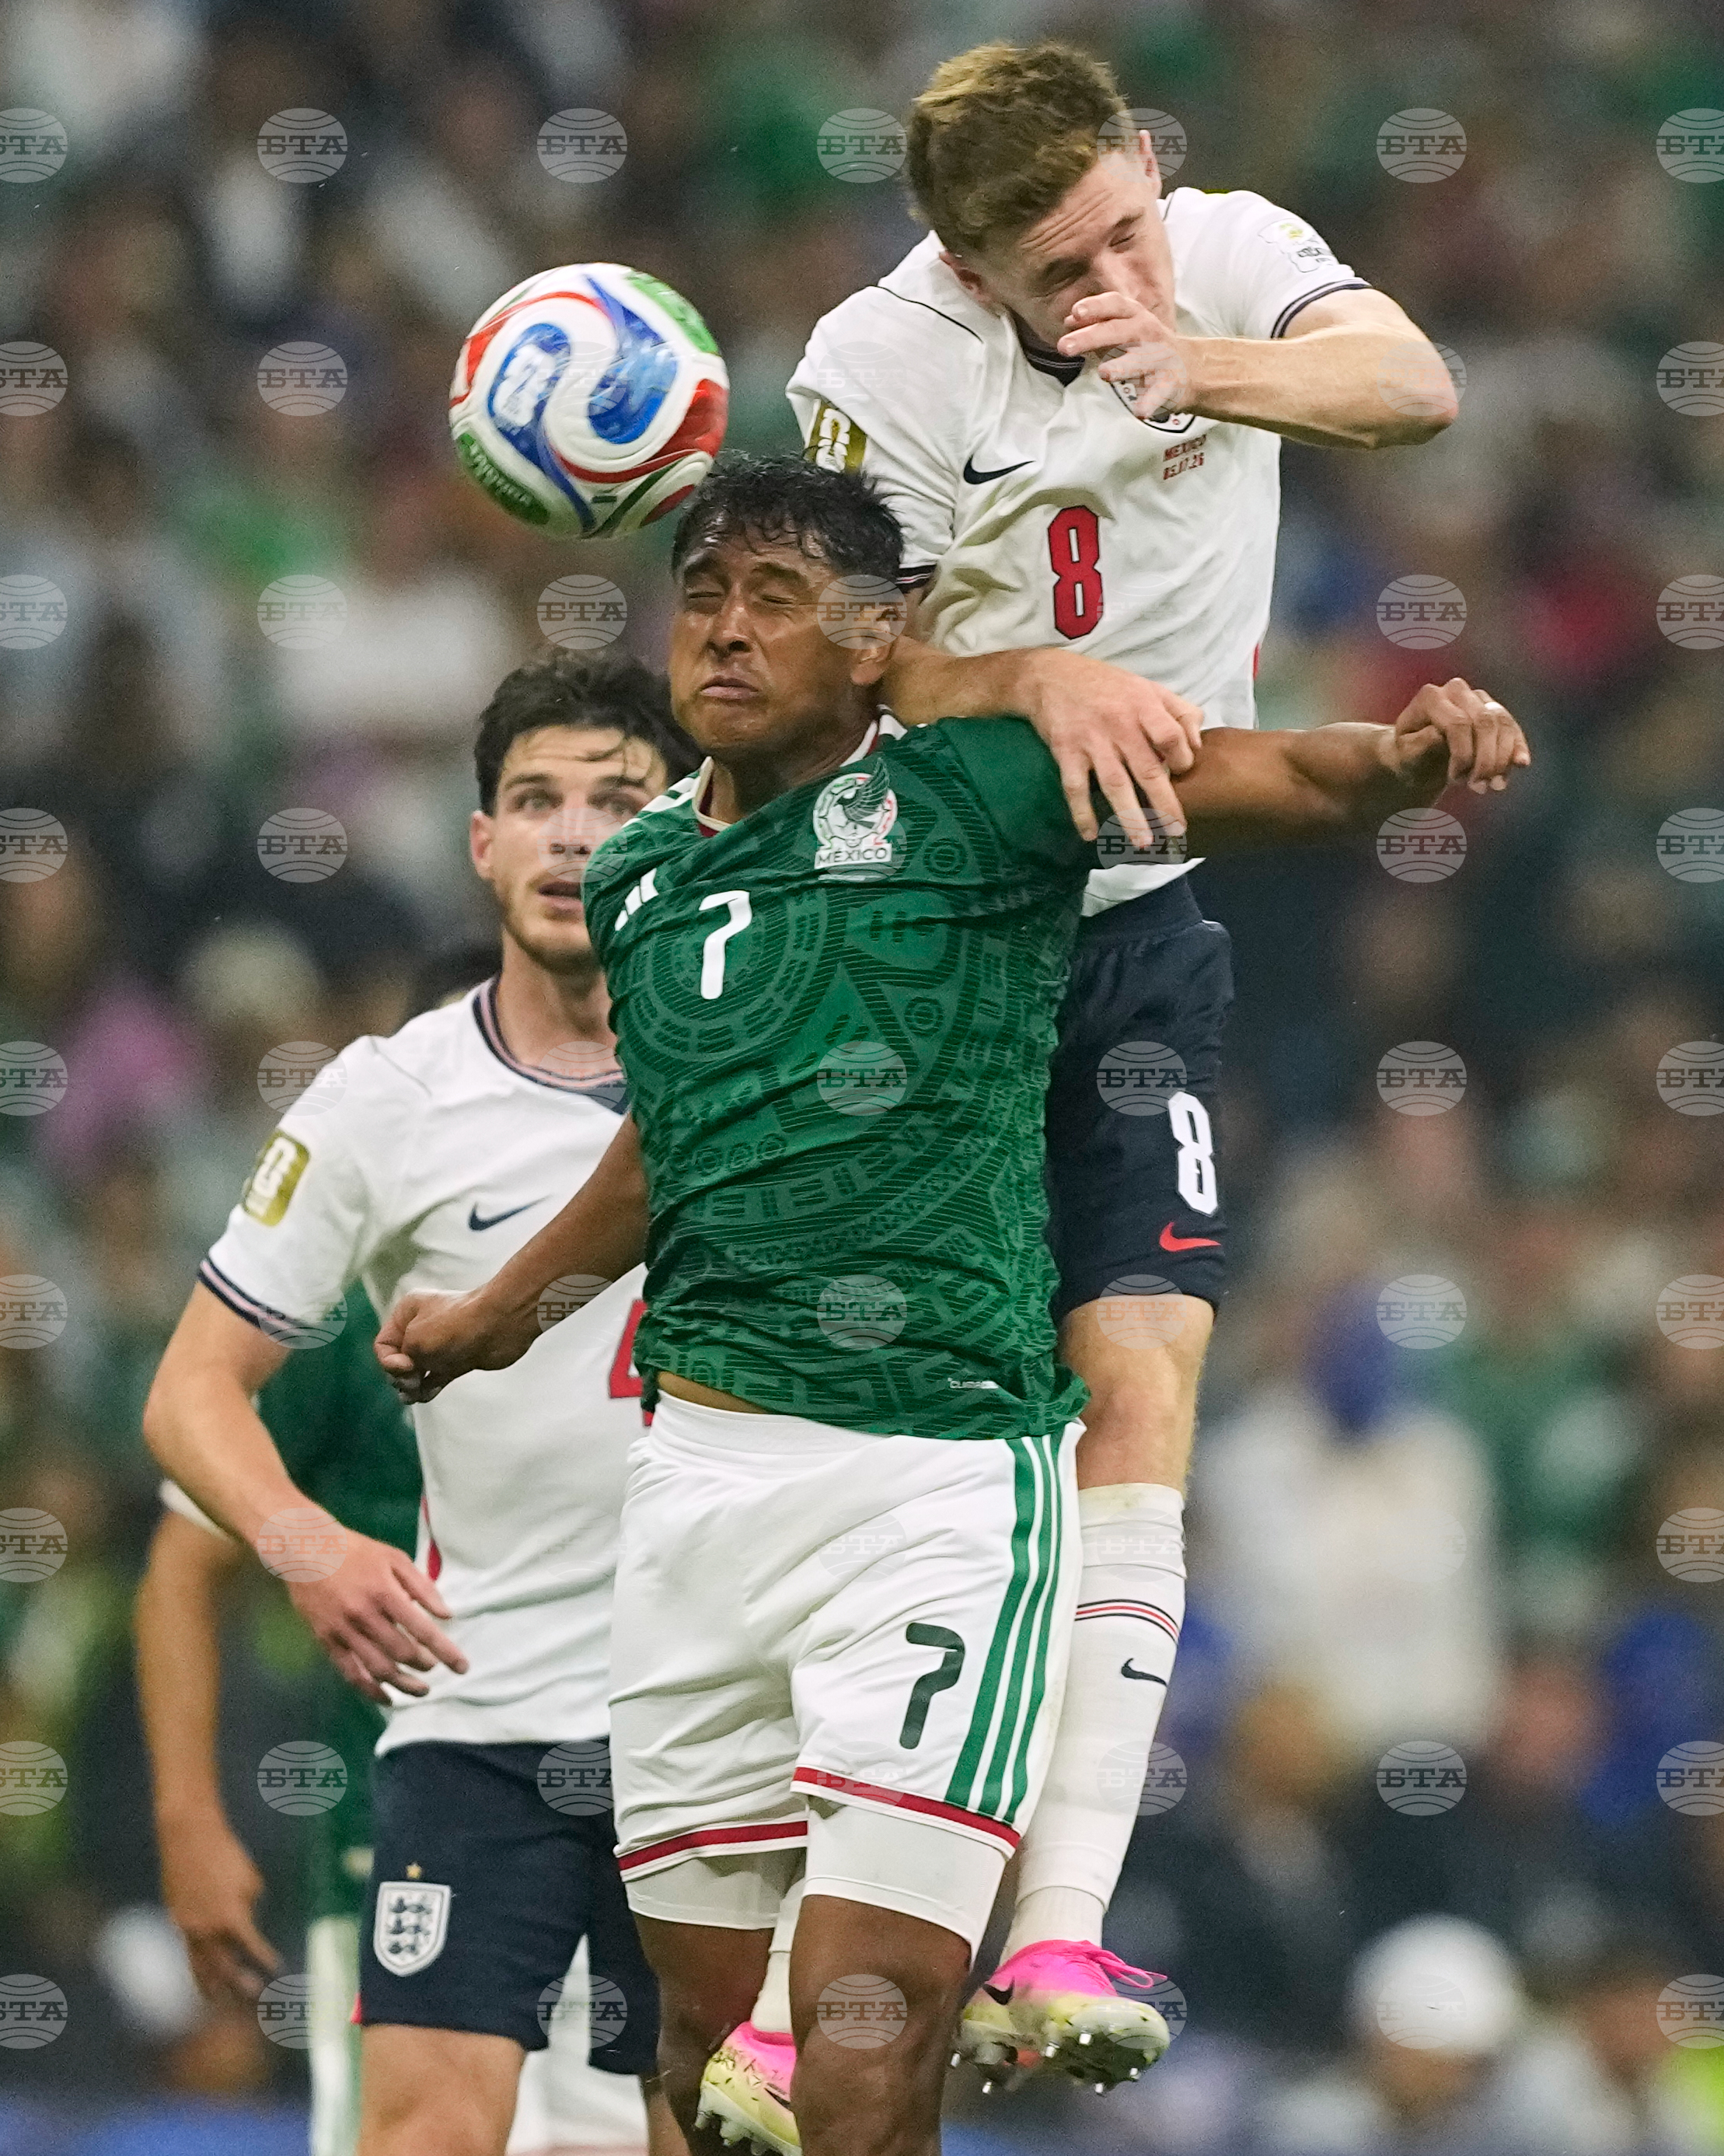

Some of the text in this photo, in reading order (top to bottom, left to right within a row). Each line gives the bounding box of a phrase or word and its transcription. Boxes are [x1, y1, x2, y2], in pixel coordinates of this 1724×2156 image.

[1048, 505, 1104, 640] 8
[699, 890, 752, 1000] 7
[1167, 1091, 1218, 1216] 8
[899, 1623, 966, 1749] 7
